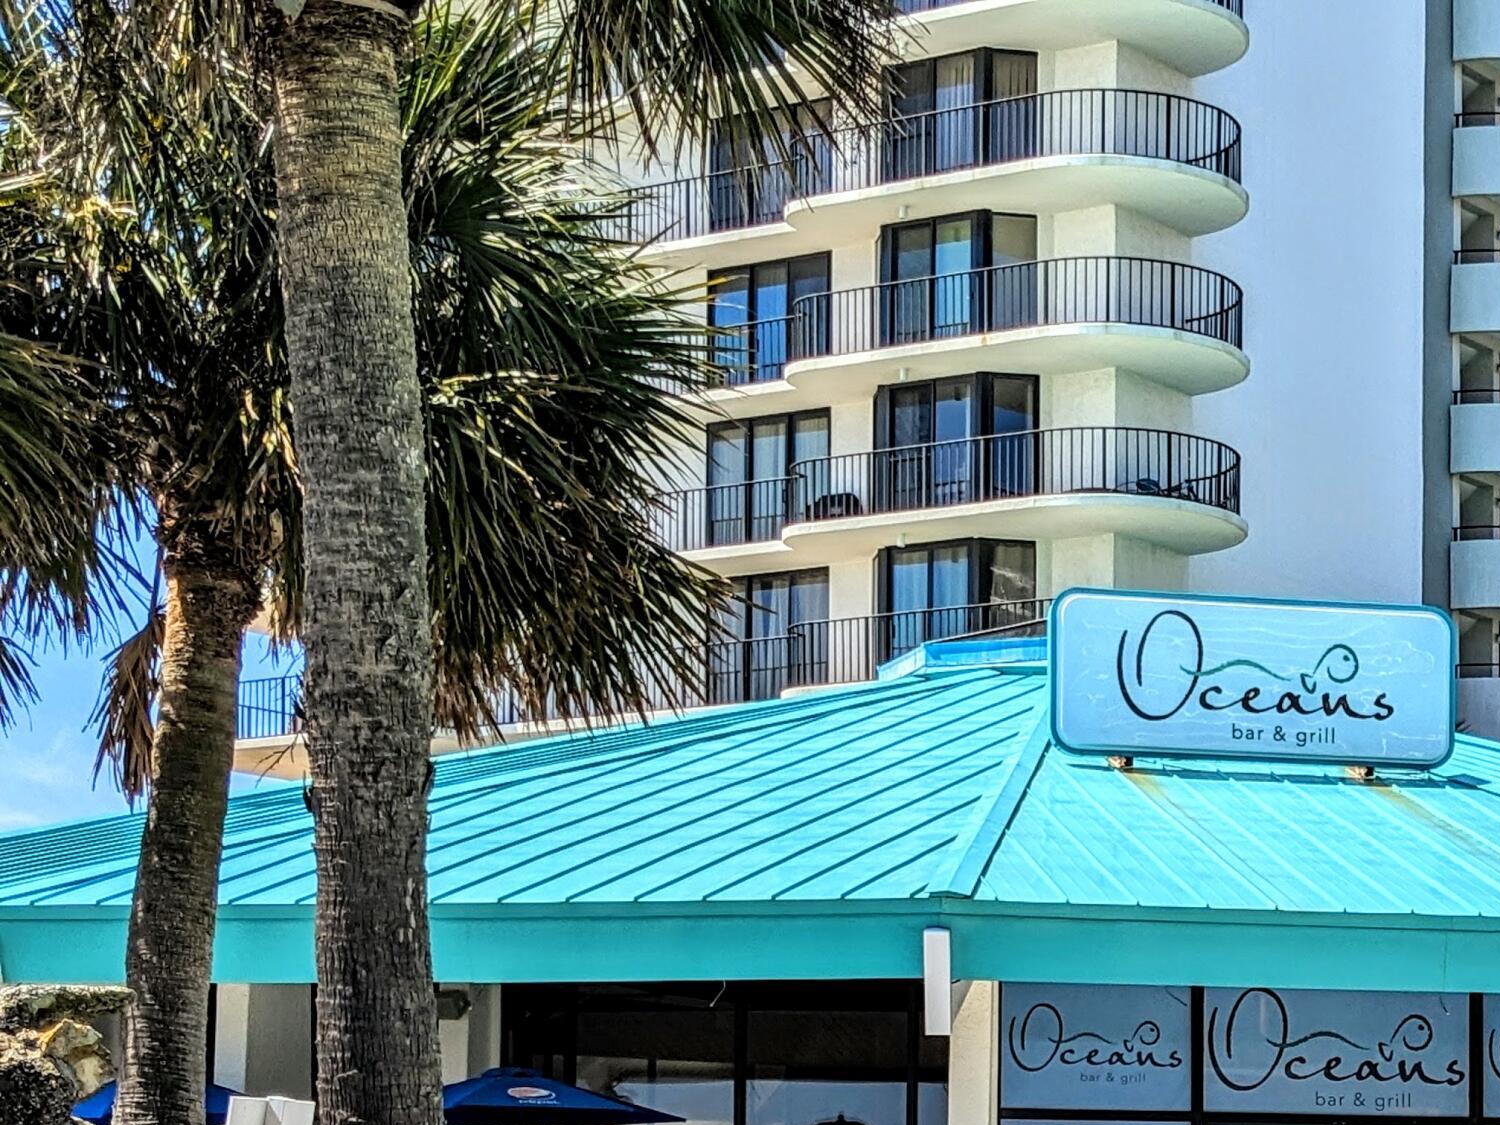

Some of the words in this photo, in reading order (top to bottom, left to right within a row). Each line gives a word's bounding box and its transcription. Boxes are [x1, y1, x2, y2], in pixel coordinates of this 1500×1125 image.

[1116, 609, 1394, 721] Oceans
[1231, 722, 1265, 741] bar
[1272, 725, 1287, 742] &
[1295, 726, 1336, 748] grill
[1008, 1002, 1183, 1072] Oceans
[1207, 987, 1466, 1092] Oceans
[1079, 1072, 1101, 1082] bar
[1105, 1073, 1114, 1082] &
[1120, 1073, 1146, 1086] grill
[1314, 1091, 1345, 1107] bar
[1353, 1092, 1366, 1107] &
[1375, 1092, 1412, 1112] grill
